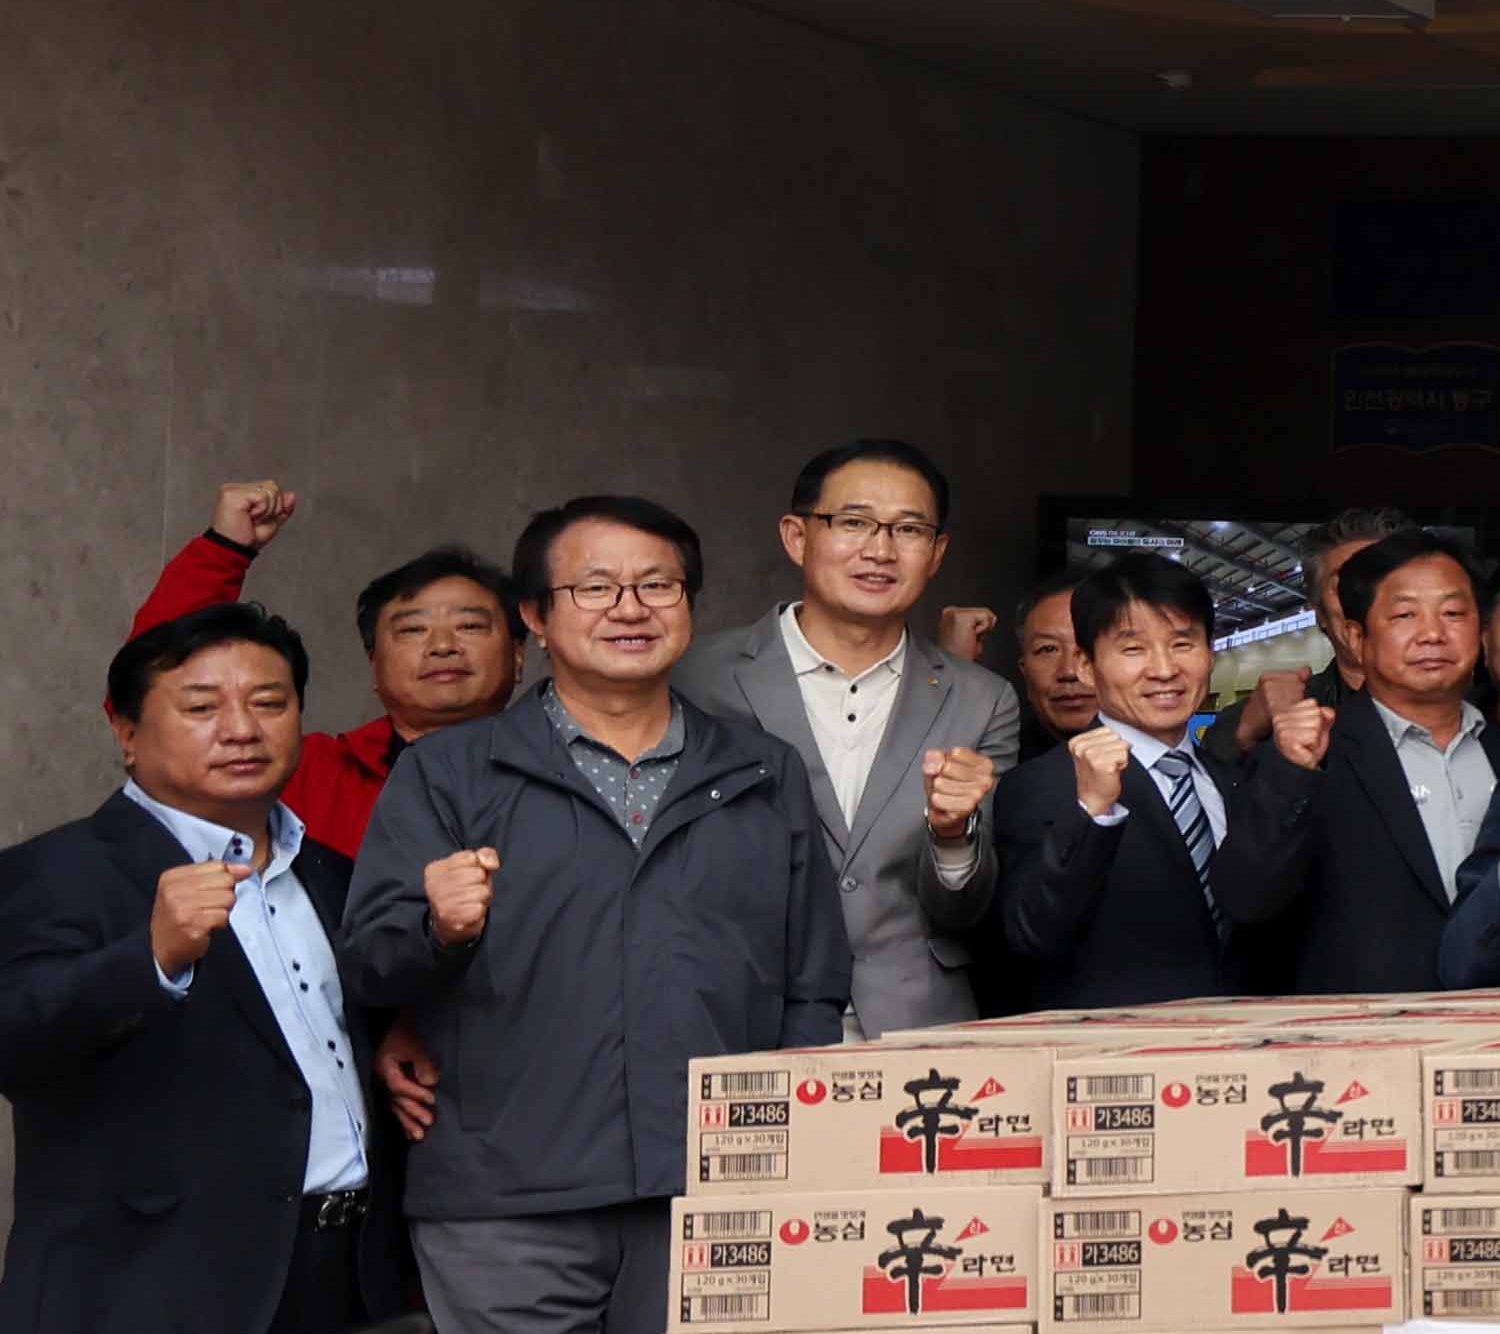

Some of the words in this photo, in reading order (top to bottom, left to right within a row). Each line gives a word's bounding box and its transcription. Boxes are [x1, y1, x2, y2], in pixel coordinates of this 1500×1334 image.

[830, 1080, 882, 1103] 농심
[732, 1103, 786, 1125] 가3486
[896, 1069, 978, 1173] 辛
[978, 1112, 1032, 1137] 라면
[1181, 1220, 1233, 1243] 농심
[1084, 1242, 1137, 1265] 가3486
[1247, 1209, 1328, 1313] 辛
[1328, 1252, 1382, 1277] 라면
